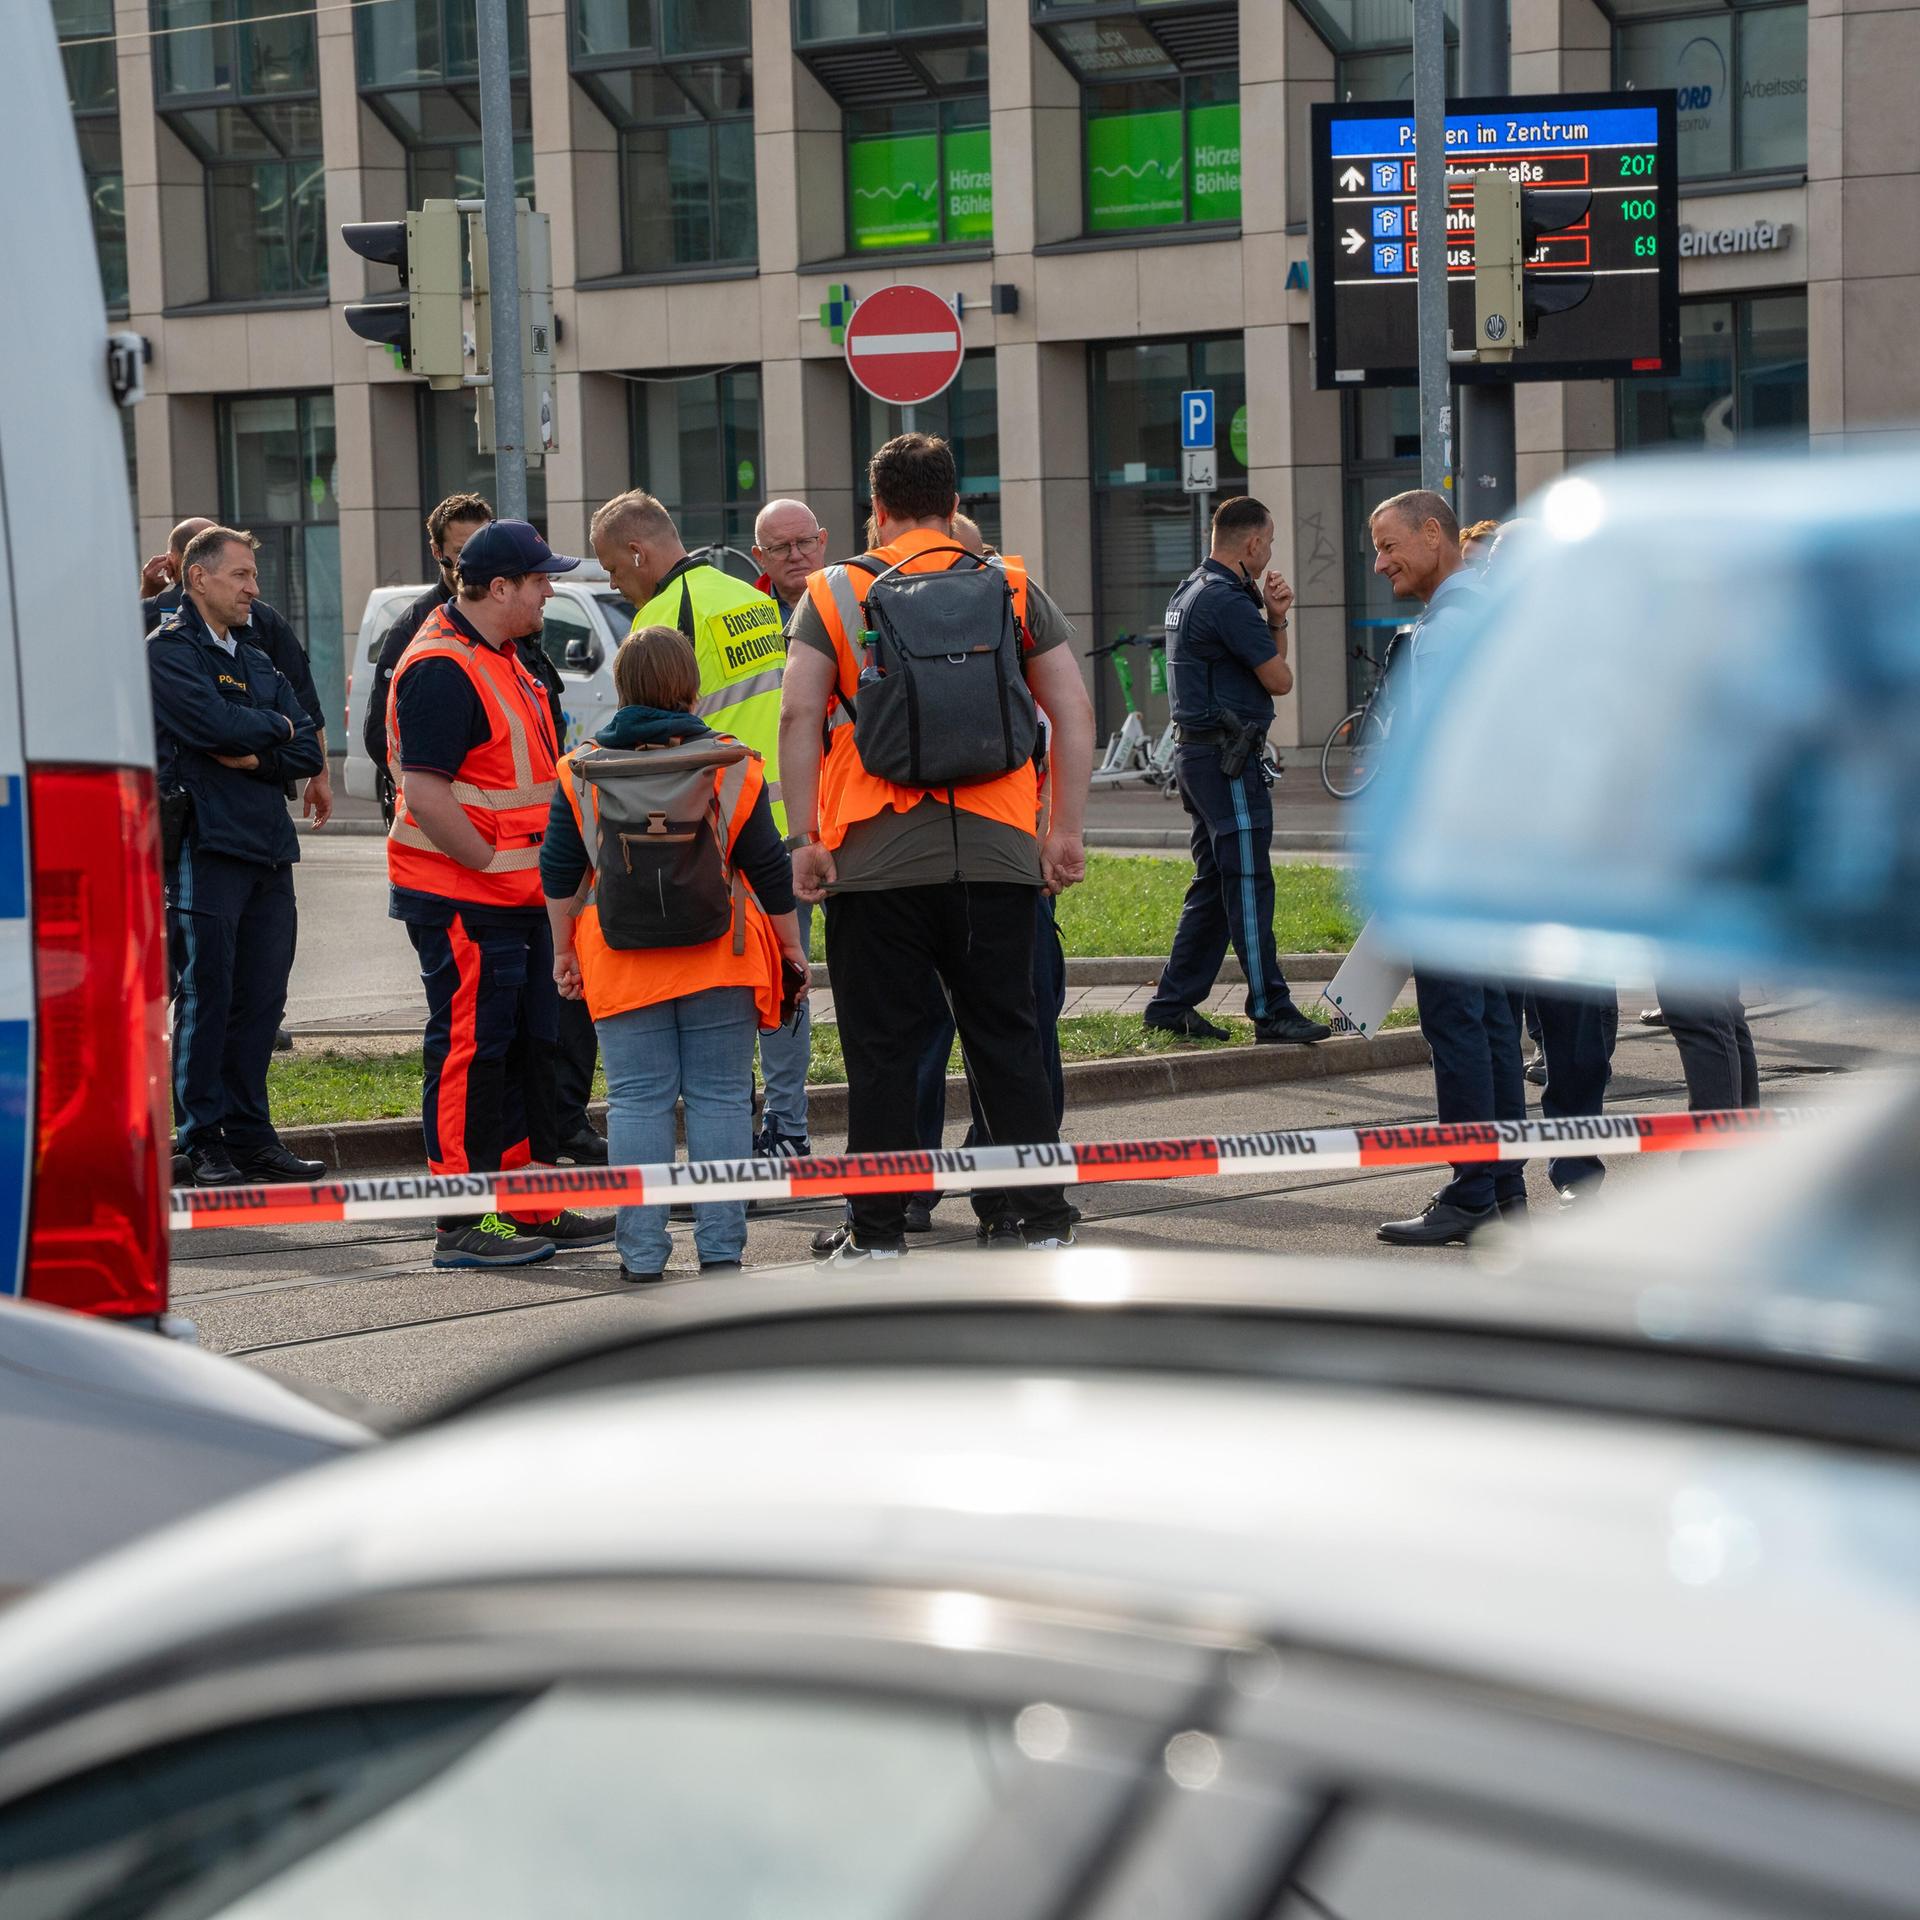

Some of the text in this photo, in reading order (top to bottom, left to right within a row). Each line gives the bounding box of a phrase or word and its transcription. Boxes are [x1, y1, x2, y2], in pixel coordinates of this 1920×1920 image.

[1399, 120, 1589, 147] Pen im Zentrum
[1195, 146, 1240, 168] Hörze
[1620, 154, 1655, 176] 207
[1621, 200, 1656, 221] 100
[1634, 235, 1656, 257] 69
[1679, 222, 1783, 257] encenter
[1189, 398, 1207, 441] P
[1016, 1133, 1317, 1168] POLIZEIABSPERRUNG
[669, 1151, 977, 1186] POLIZEIABSPERRUNG
